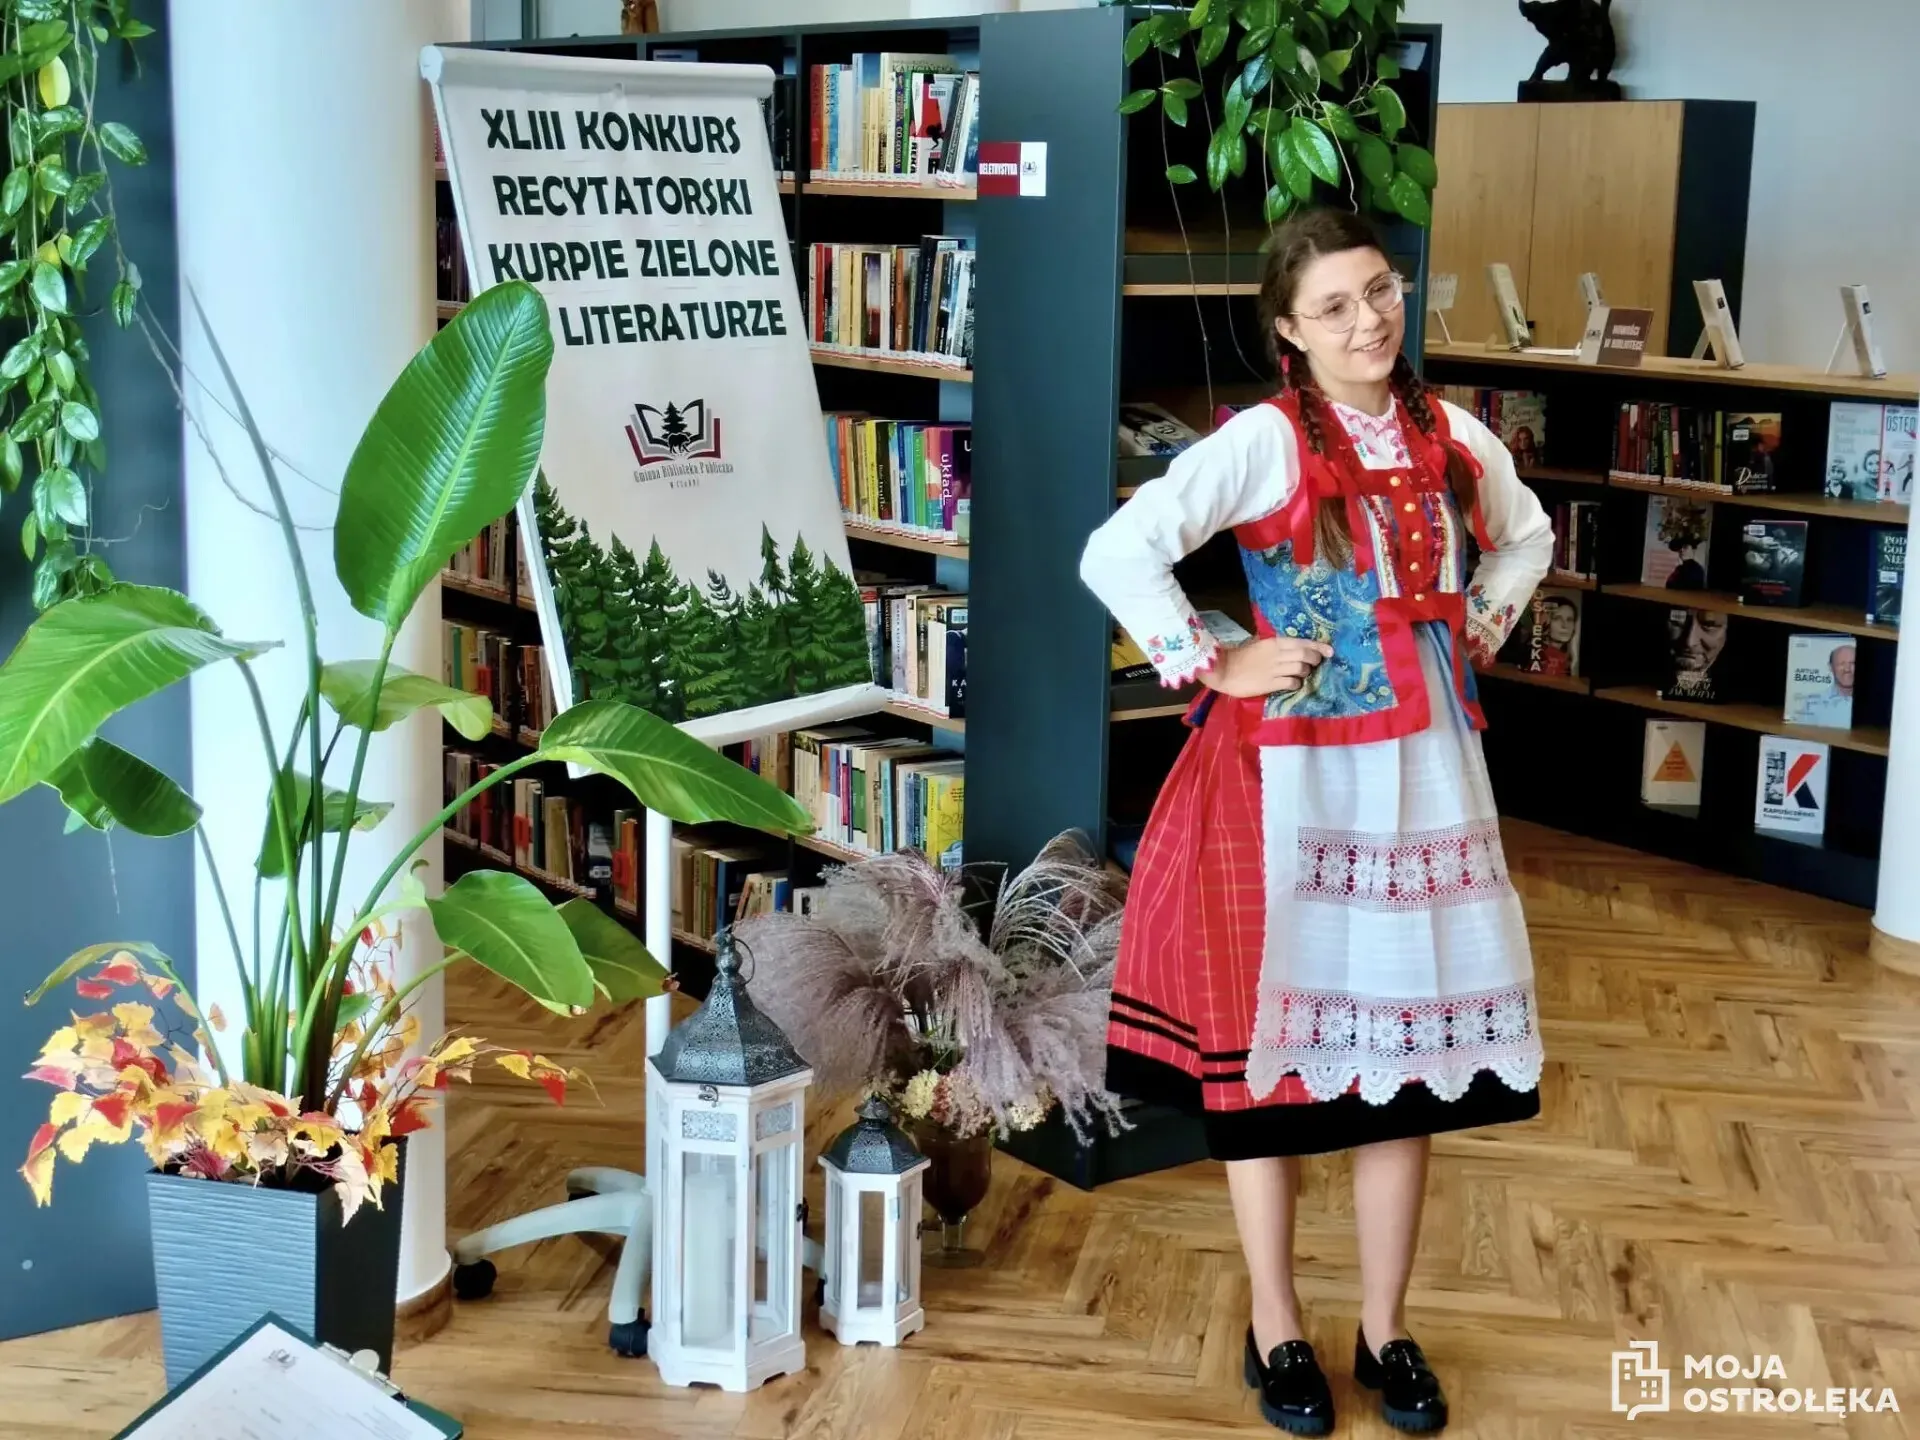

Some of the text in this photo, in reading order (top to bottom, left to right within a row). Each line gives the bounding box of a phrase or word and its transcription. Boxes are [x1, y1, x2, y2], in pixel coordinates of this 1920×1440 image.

[481, 108, 566, 151] XLIII
[577, 110, 741, 155] KONKURS
[492, 175, 754, 216] RECYTATORSKI
[488, 239, 780, 284] KURPIE ZIELONE
[559, 299, 787, 346] LITERATURZE
[634, 462, 734, 483] Gminna Biblioteka Publiczna
[1531, 590, 1544, 672] OSIECKA
[1794, 673, 1832, 684] BARCIŚ
